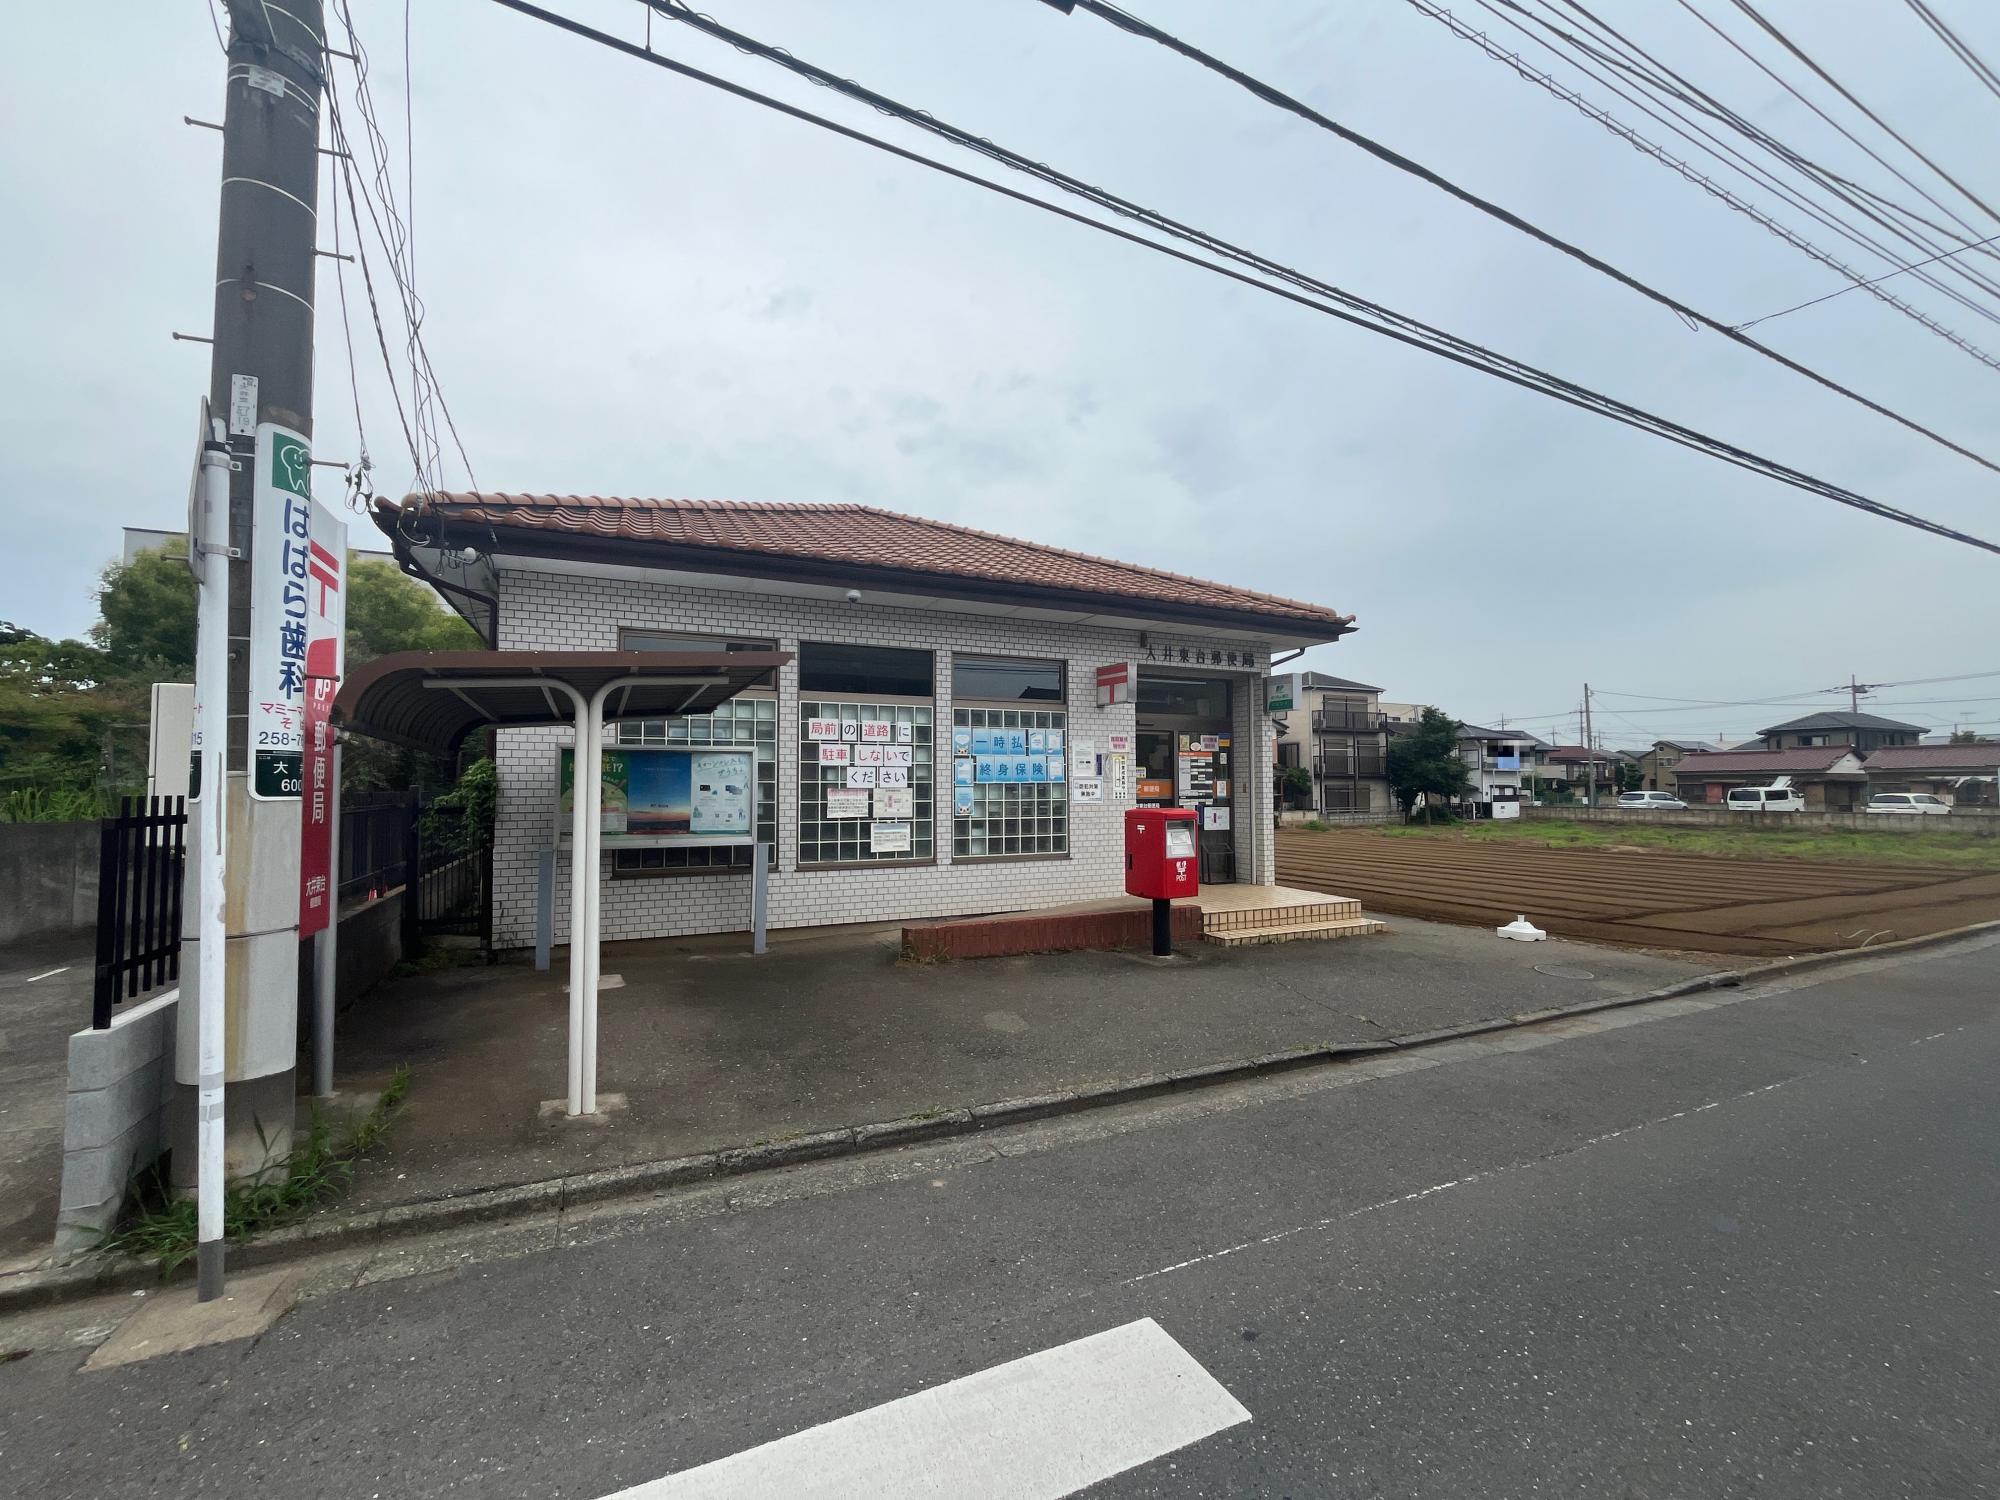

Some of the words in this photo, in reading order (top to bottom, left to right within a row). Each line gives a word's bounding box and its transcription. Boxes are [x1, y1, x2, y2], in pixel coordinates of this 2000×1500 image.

[811, 722, 910, 738] 局前の道路に
[975, 735, 1023, 749] 一時払
[821, 748, 911, 762] 駐車しないで
[312, 720, 328, 825] 郵便局
[979, 762, 1045, 776] 終身保険
[850, 770, 906, 784] ください
[1175, 874, 1187, 882] POST
